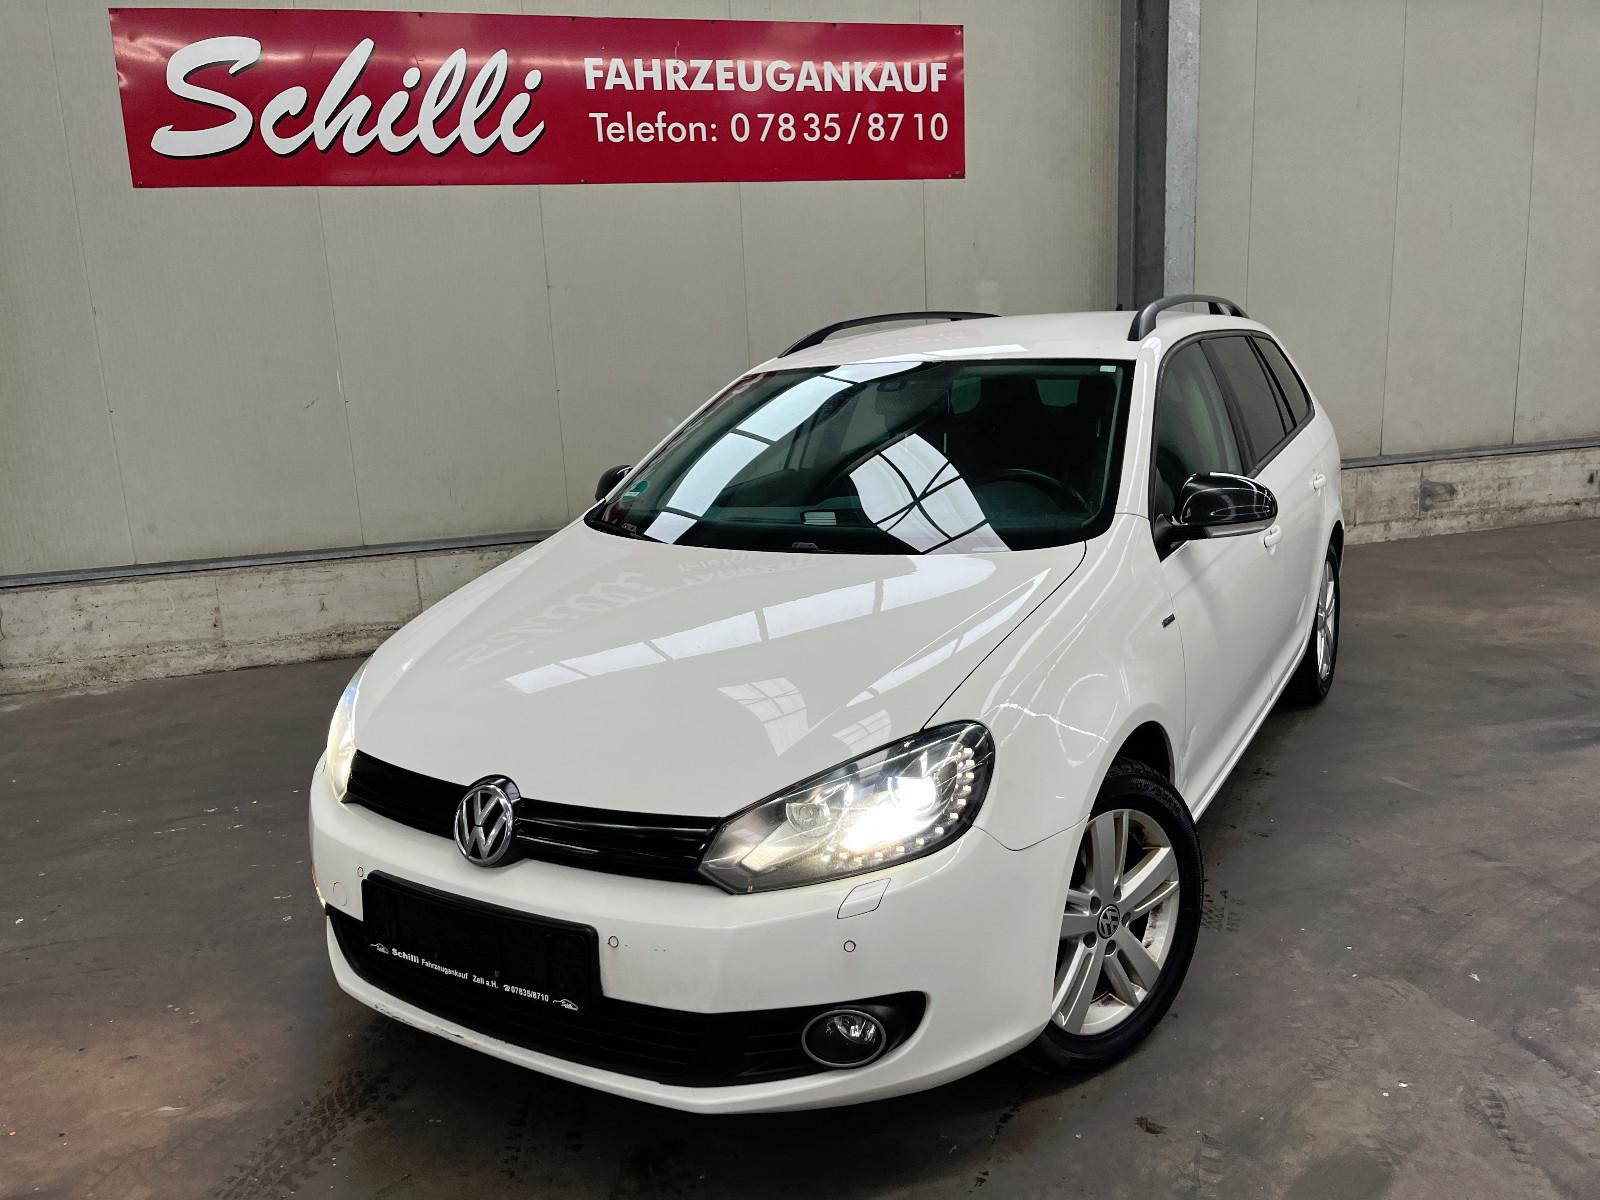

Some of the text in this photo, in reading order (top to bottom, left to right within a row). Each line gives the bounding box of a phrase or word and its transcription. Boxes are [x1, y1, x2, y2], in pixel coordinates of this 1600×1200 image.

[151, 36, 545, 156] Schilli
[584, 57, 948, 92] FAHRZEUGANKAUF
[589, 111, 718, 142] Telefon:
[391, 948, 420, 964] Schilli
[421, 958, 468, 980] Fahrzeugankauf
[510, 985, 549, 1002] 07835/8710
